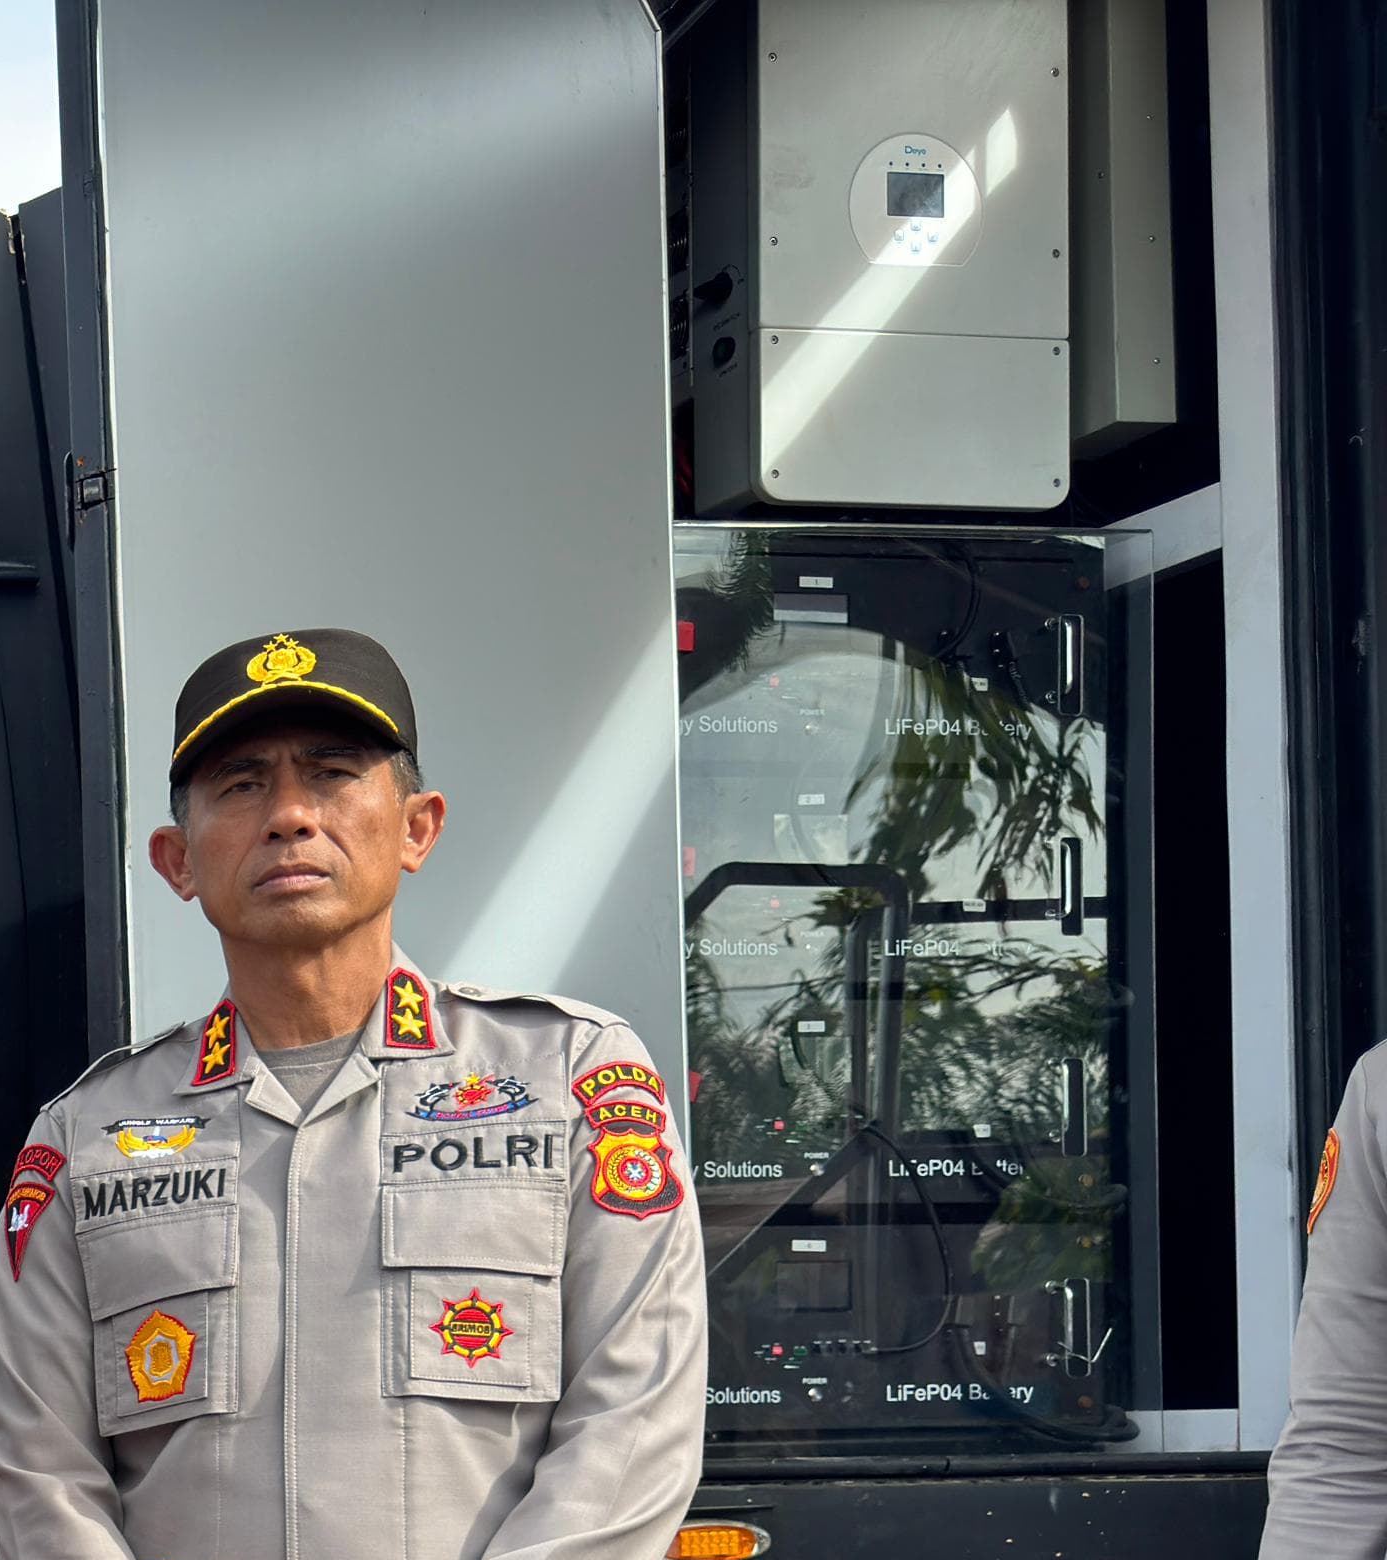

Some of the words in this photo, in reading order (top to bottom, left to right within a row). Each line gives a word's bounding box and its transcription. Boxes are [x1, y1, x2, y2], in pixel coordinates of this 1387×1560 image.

[699, 715, 778, 733] Solutions
[699, 938, 778, 956] Solutions
[581, 1065, 660, 1097] POLDA
[599, 1105, 658, 1123] ACEH
[393, 1134, 554, 1174] POLRI
[703, 1160, 783, 1178] Solutions
[82, 1168, 226, 1221] MARZUKI
[706, 1387, 781, 1404] Solutions
